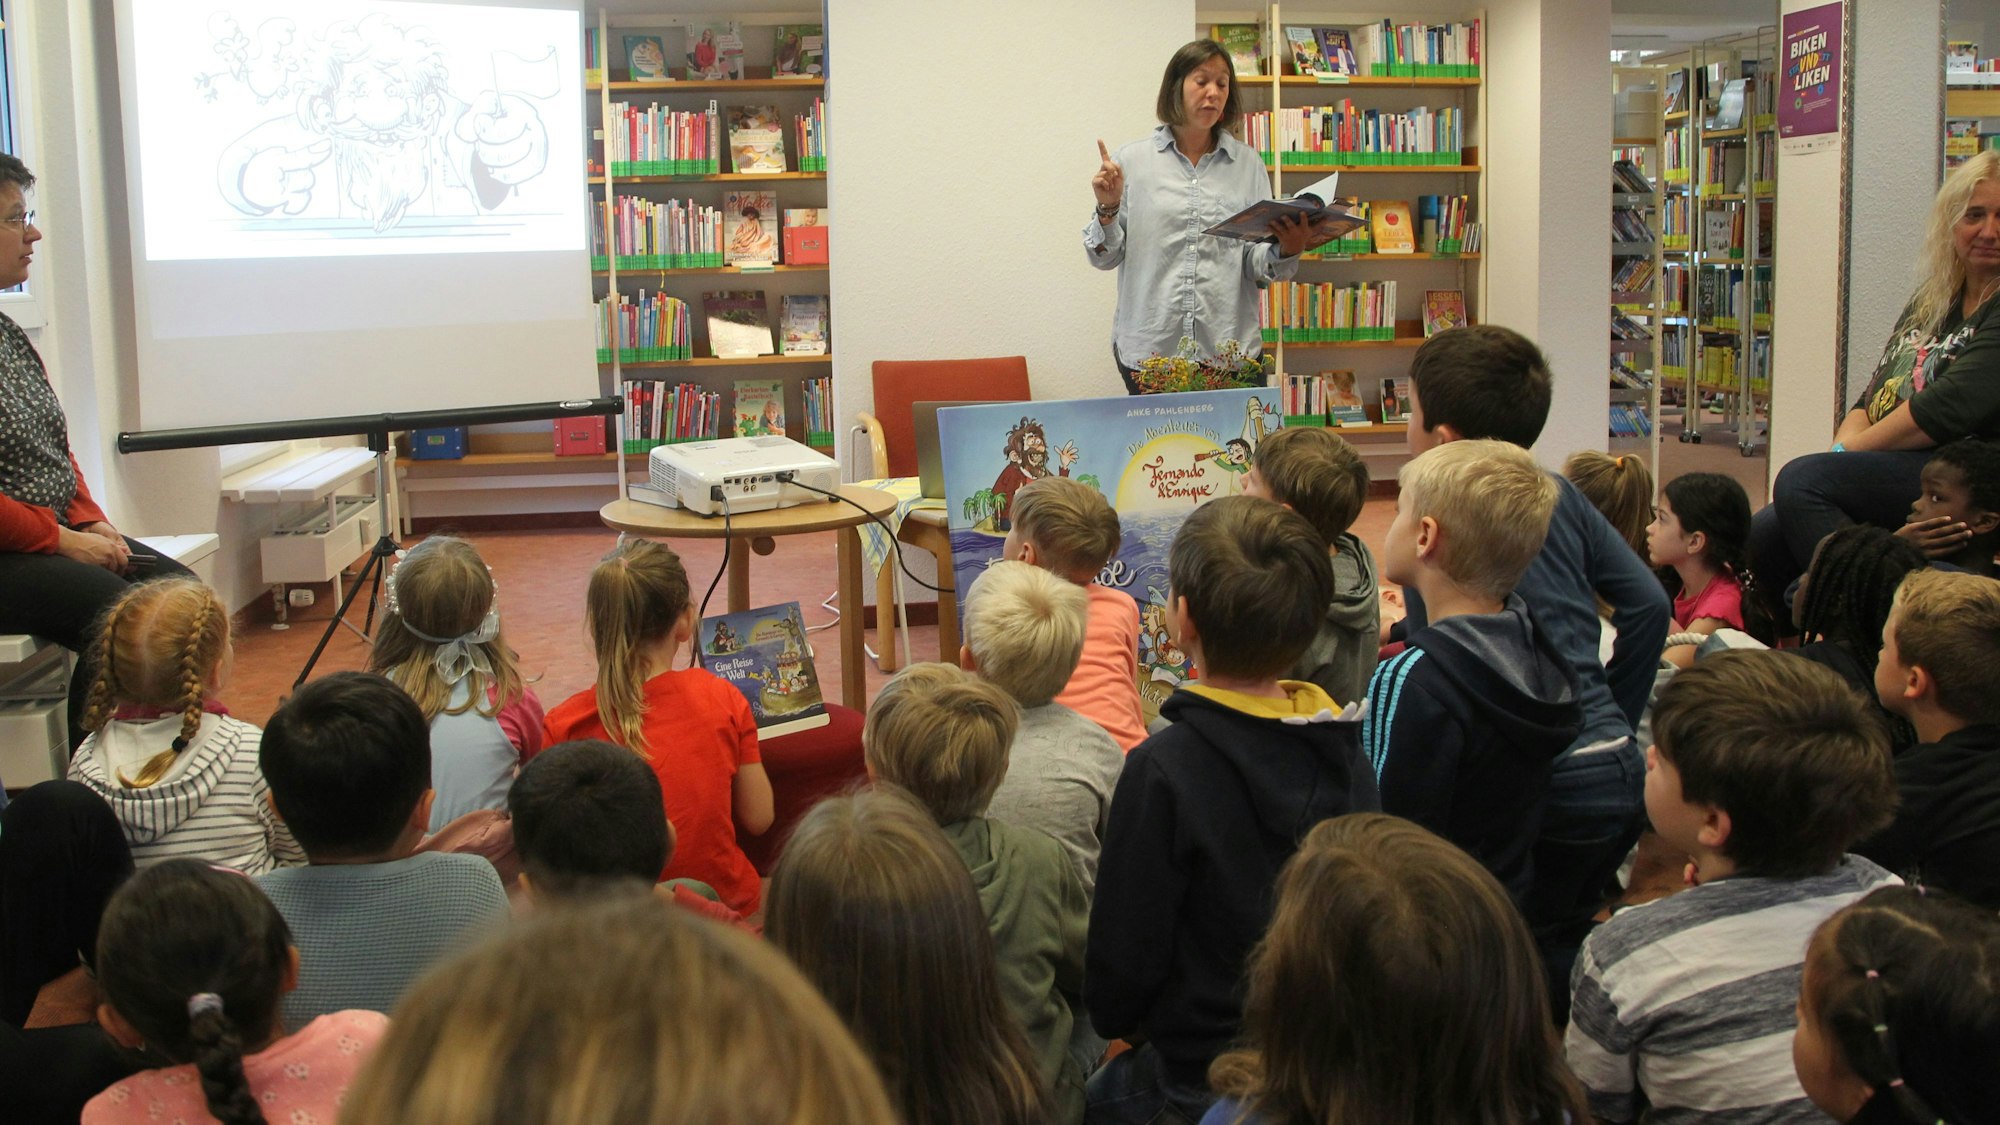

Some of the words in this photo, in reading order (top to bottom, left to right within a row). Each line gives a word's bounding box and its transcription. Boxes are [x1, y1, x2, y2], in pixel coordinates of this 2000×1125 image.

[1790, 32, 1827, 59] BIKEN
[1800, 52, 1819, 73] UND
[1794, 65, 1830, 91] LIKEN
[1127, 408, 1151, 417] ANKE
[1155, 404, 1213, 415] PAHLENBERG
[1128, 441, 1143, 456] Die
[1145, 419, 1200, 440] Abenteuer
[1203, 427, 1220, 440] von
[1142, 455, 1205, 489] Fernando
[715, 661, 732, 672] Eine
[732, 657, 754, 669] Reise
[726, 669, 746, 680] Welt
